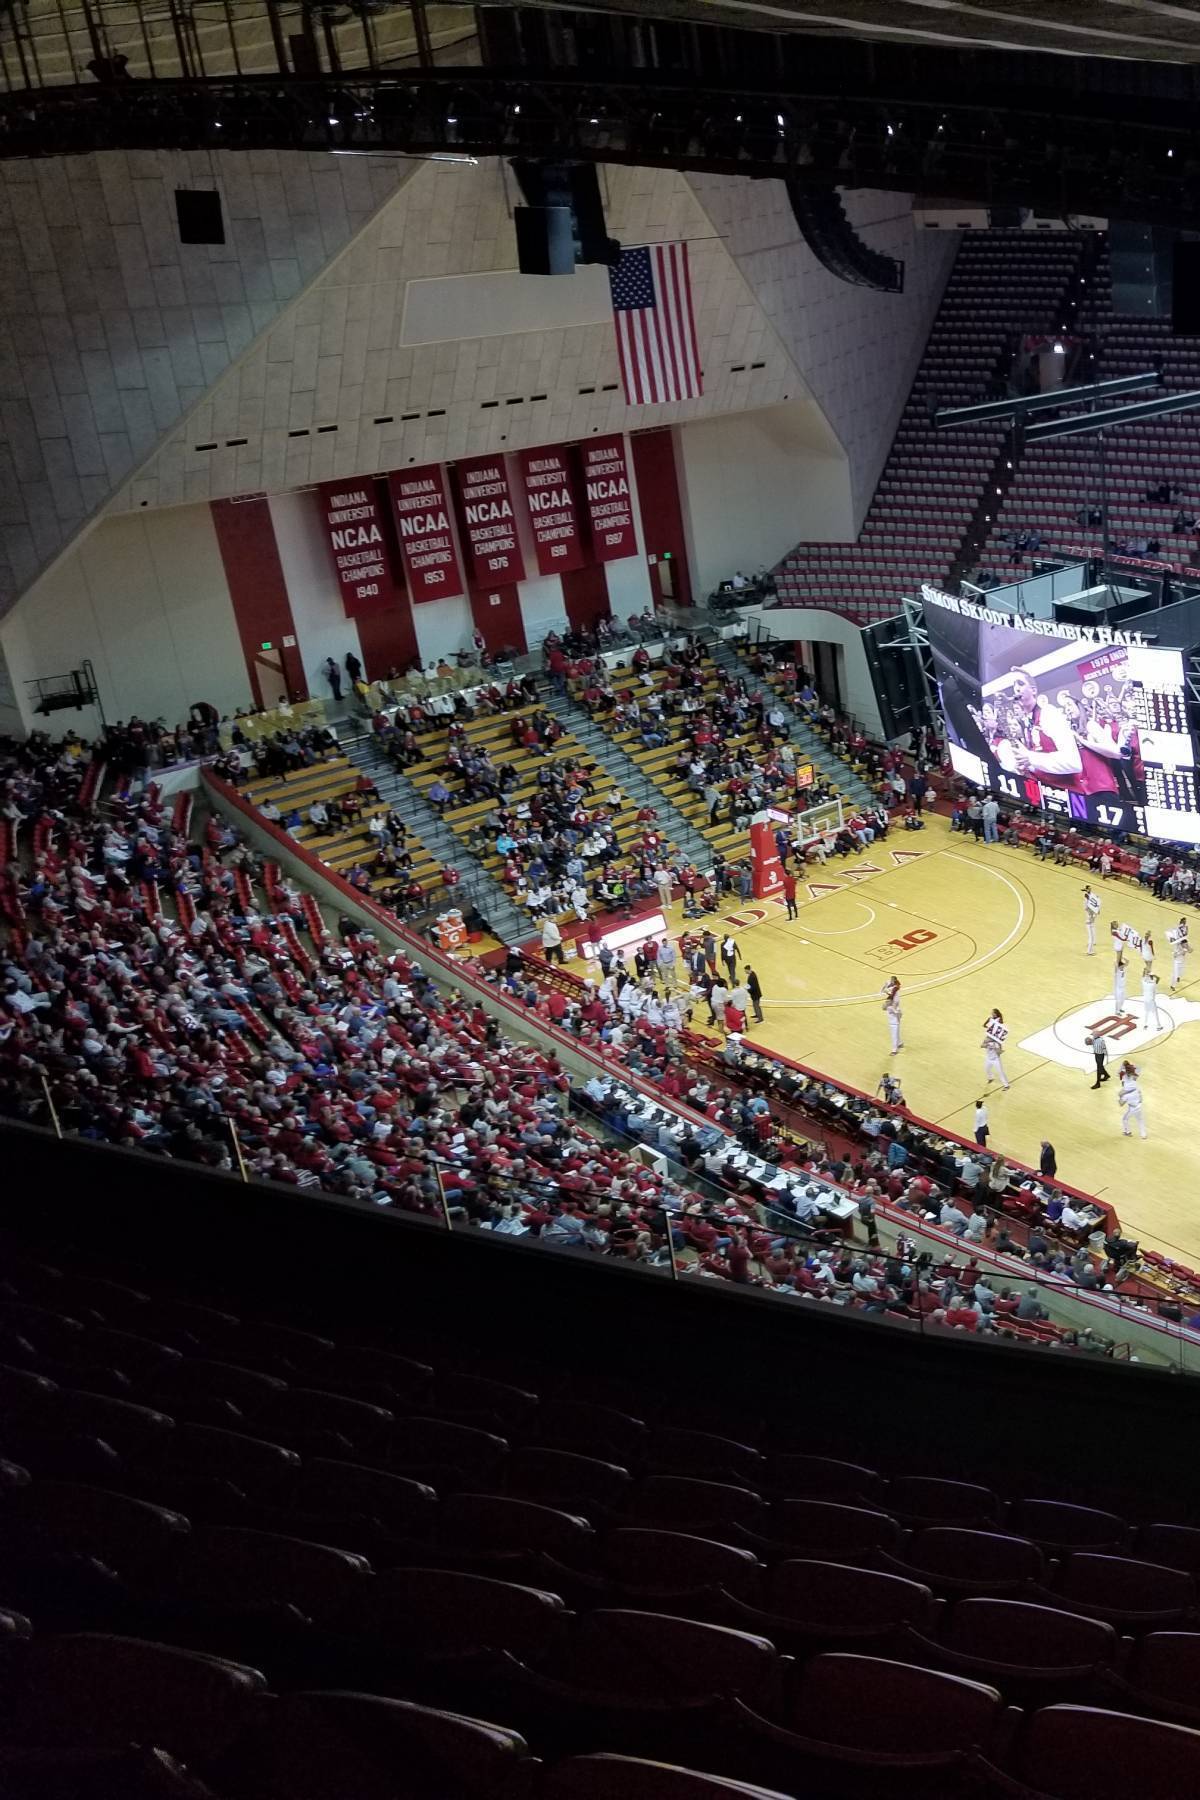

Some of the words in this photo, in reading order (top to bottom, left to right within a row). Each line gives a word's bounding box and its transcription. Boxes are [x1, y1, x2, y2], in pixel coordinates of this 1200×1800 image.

[588, 447, 619, 462] INDIANA
[528, 458, 561, 472] INDIANA
[585, 461, 624, 477] UNIVERSITY
[466, 468, 500, 484] INDIANA
[525, 471, 567, 488] UNIVERSITY
[400, 479, 436, 495] INDIANA
[463, 481, 508, 499] UNIVERSITY
[586, 478, 628, 501] NCAA
[330, 491, 368, 508] INDIANA
[398, 493, 443, 511] UNIVERSITY
[528, 488, 572, 512] NCAA
[328, 505, 375, 524] UNIVERSITY
[465, 500, 513, 524] NCAA
[590, 501, 630, 517] BASKETBALL
[400, 512, 449, 536] NCAA
[533, 511, 574, 529] BASKETBALL
[594, 514, 630, 531] CHAMPIONS
[331, 524, 382, 550] NCAA
[470, 523, 514, 541] BASKETBALL
[537, 525, 574, 542] CHAMPIONS
[405, 536, 451, 554] BASKETBALL
[474, 538, 515, 555] CHAMPIONS
[336, 549, 384, 568] BASKETBALL
[410, 550, 452, 568] CHAMPIONS
[488, 557, 509, 570] 1976
[342, 563, 385, 582] CHAMPIONS
[356, 584, 379, 599] 1940
[1012, 614, 1100, 643] ASSEMBLY
[1097, 625, 1148, 648] HALL
[998, 775, 1021, 797] 11
[1096, 804, 1124, 826] 17
